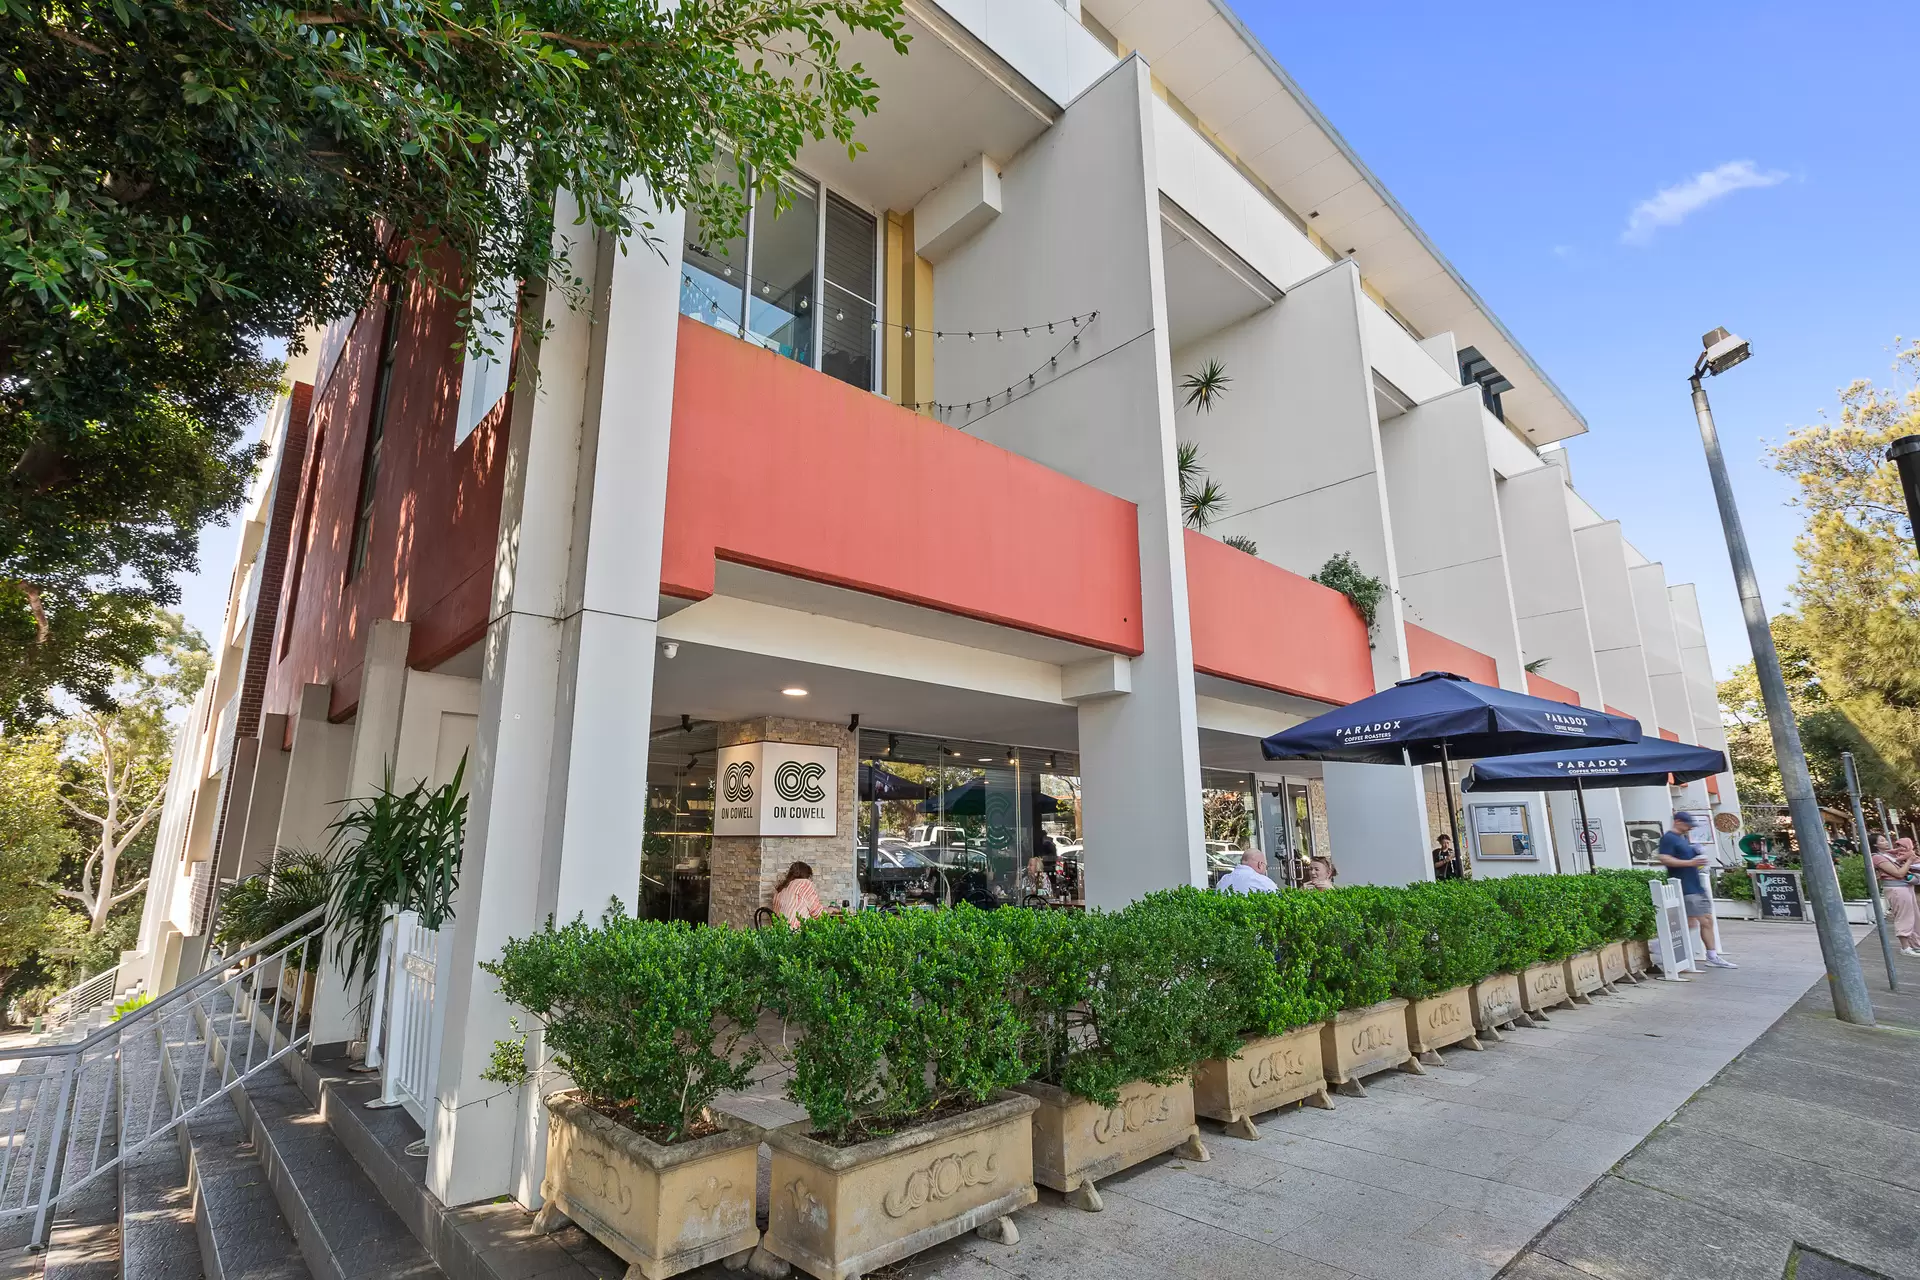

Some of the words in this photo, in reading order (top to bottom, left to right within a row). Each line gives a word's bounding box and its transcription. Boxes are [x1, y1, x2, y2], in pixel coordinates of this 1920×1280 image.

[1545, 712, 1588, 726] PARADOX
[1336, 720, 1401, 737] PARADOX
[1344, 735, 1363, 743] COFFEE
[1364, 732, 1391, 740] ROASTERS
[1557, 759, 1627, 769] PARADOX
[723, 761, 755, 802] OC
[774, 761, 826, 803] OC
[721, 808, 730, 819] ON
[730, 807, 753, 819] COWELL
[773, 806, 787, 819] ON
[789, 807, 825, 819] COWELL
